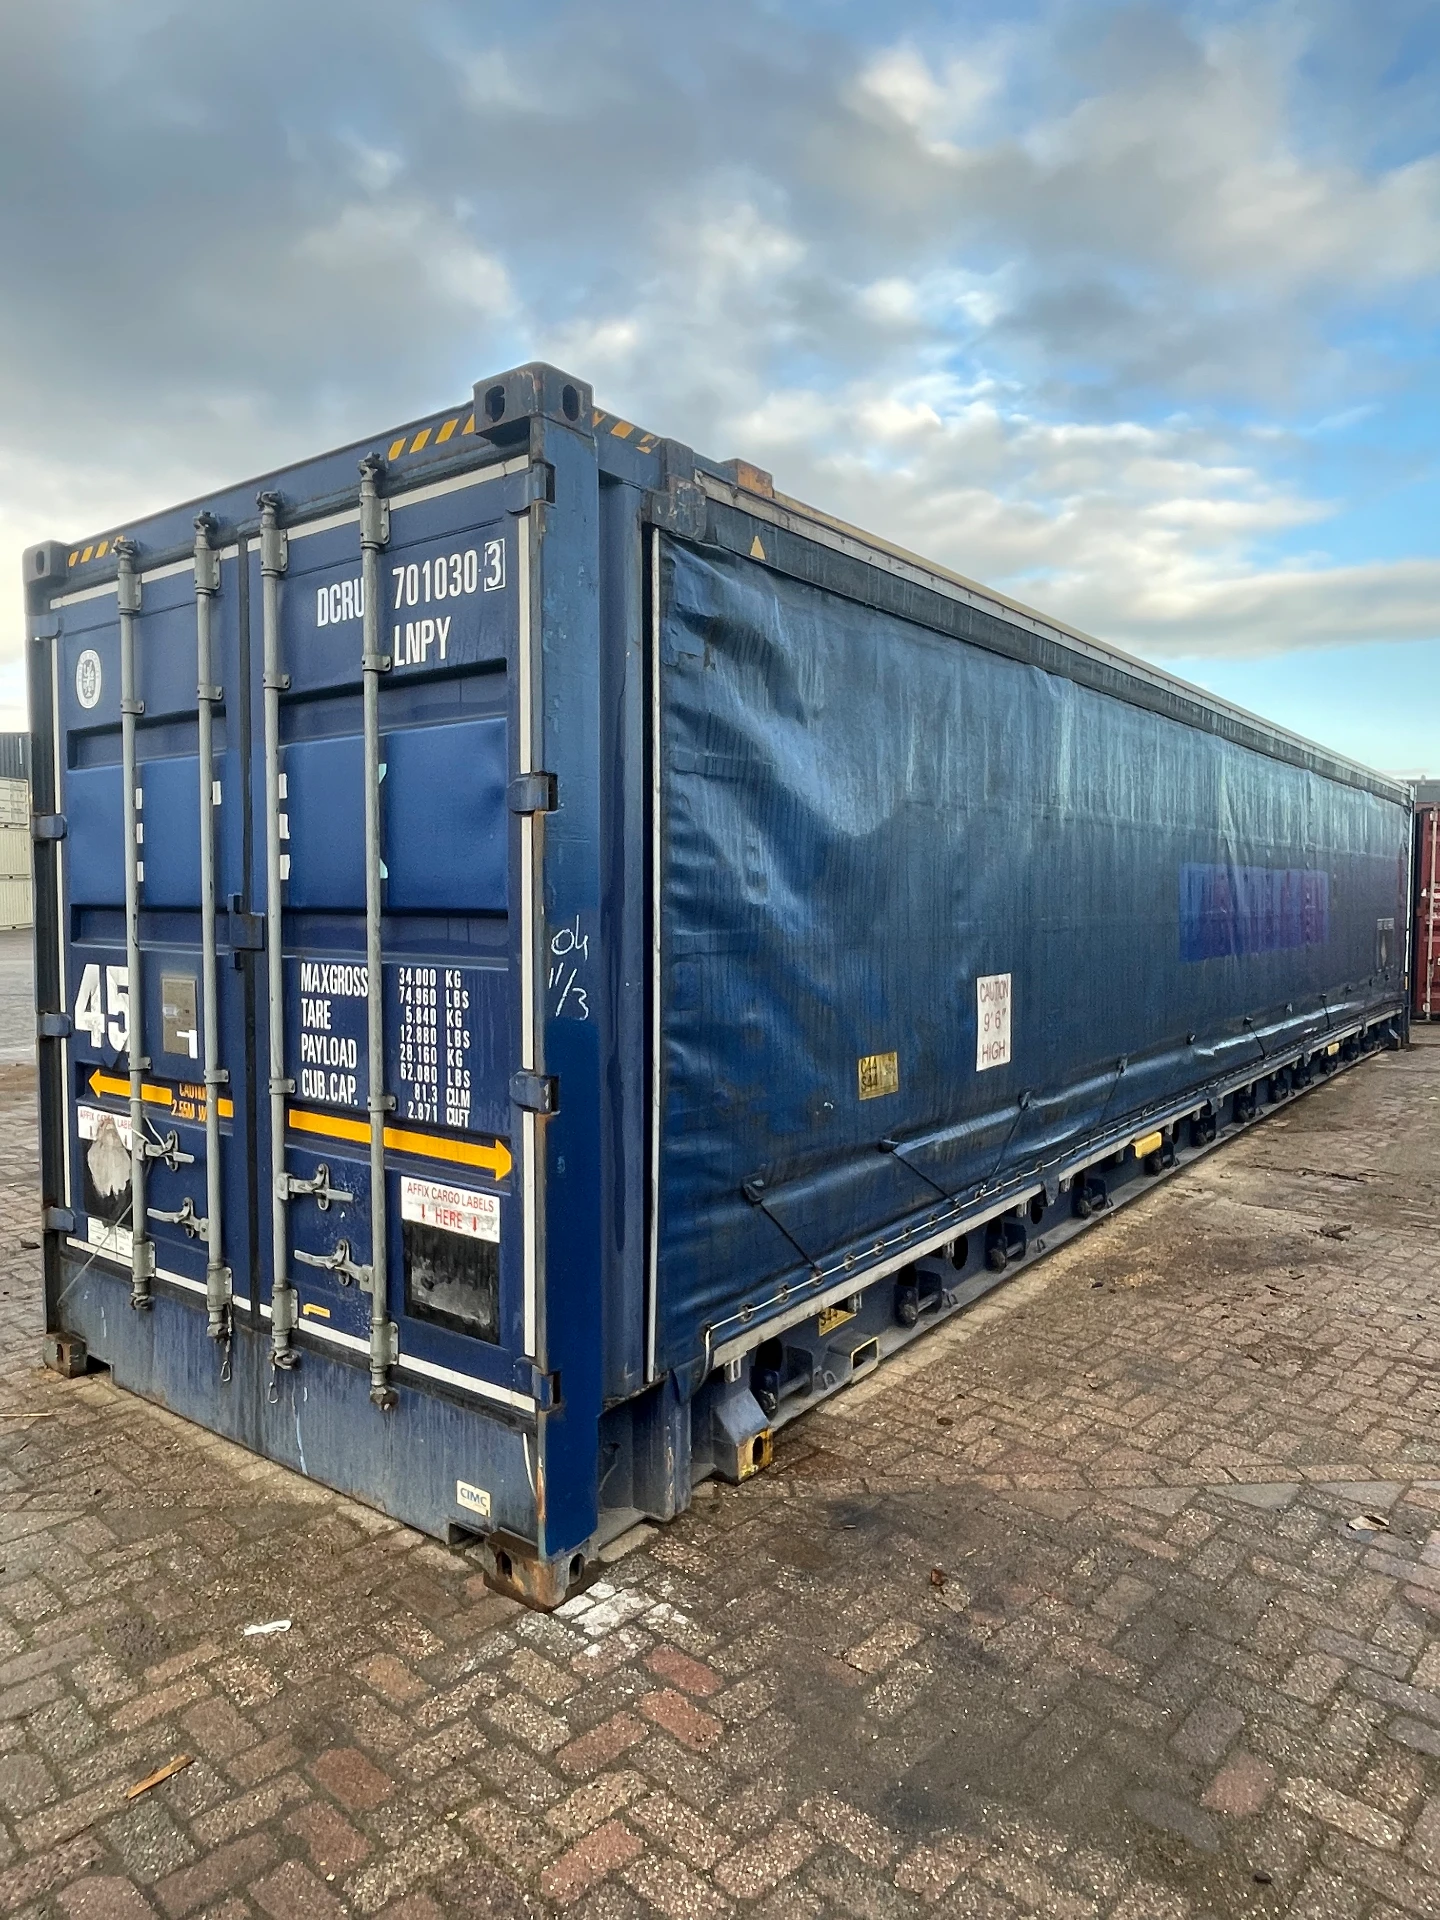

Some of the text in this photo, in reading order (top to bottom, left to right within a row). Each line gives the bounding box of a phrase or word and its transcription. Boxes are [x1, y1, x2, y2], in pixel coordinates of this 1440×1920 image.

[317, 541, 503, 627] DCRU 701030 3
[393, 616, 452, 667] LNPY
[300, 963, 368, 997] MAXGROSS
[445, 970, 461, 988] KG
[445, 990, 469, 1009] LBS
[979, 980, 1008, 1002] CAUTION
[74, 963, 130, 1053] 45
[301, 998, 332, 1030] TARE
[446, 1010, 462, 1028] KG
[446, 1029, 470, 1049] LBS
[301, 1033, 357, 1069] PAYLOAD
[446, 1048, 463, 1068] KG
[982, 1039, 1006, 1063] HIGH
[301, 1068, 359, 1106] CUB.CAP.
[447, 1068, 471, 1088] LBS
[179, 1082, 207, 1101] CAUTIO
[414, 1083, 438, 1104] 81.3
[407, 1182, 495, 1213] AFFIX CARGO LABELS
[435, 1206, 463, 1230] HERE
[460, 1487, 488, 1507] CIMC
